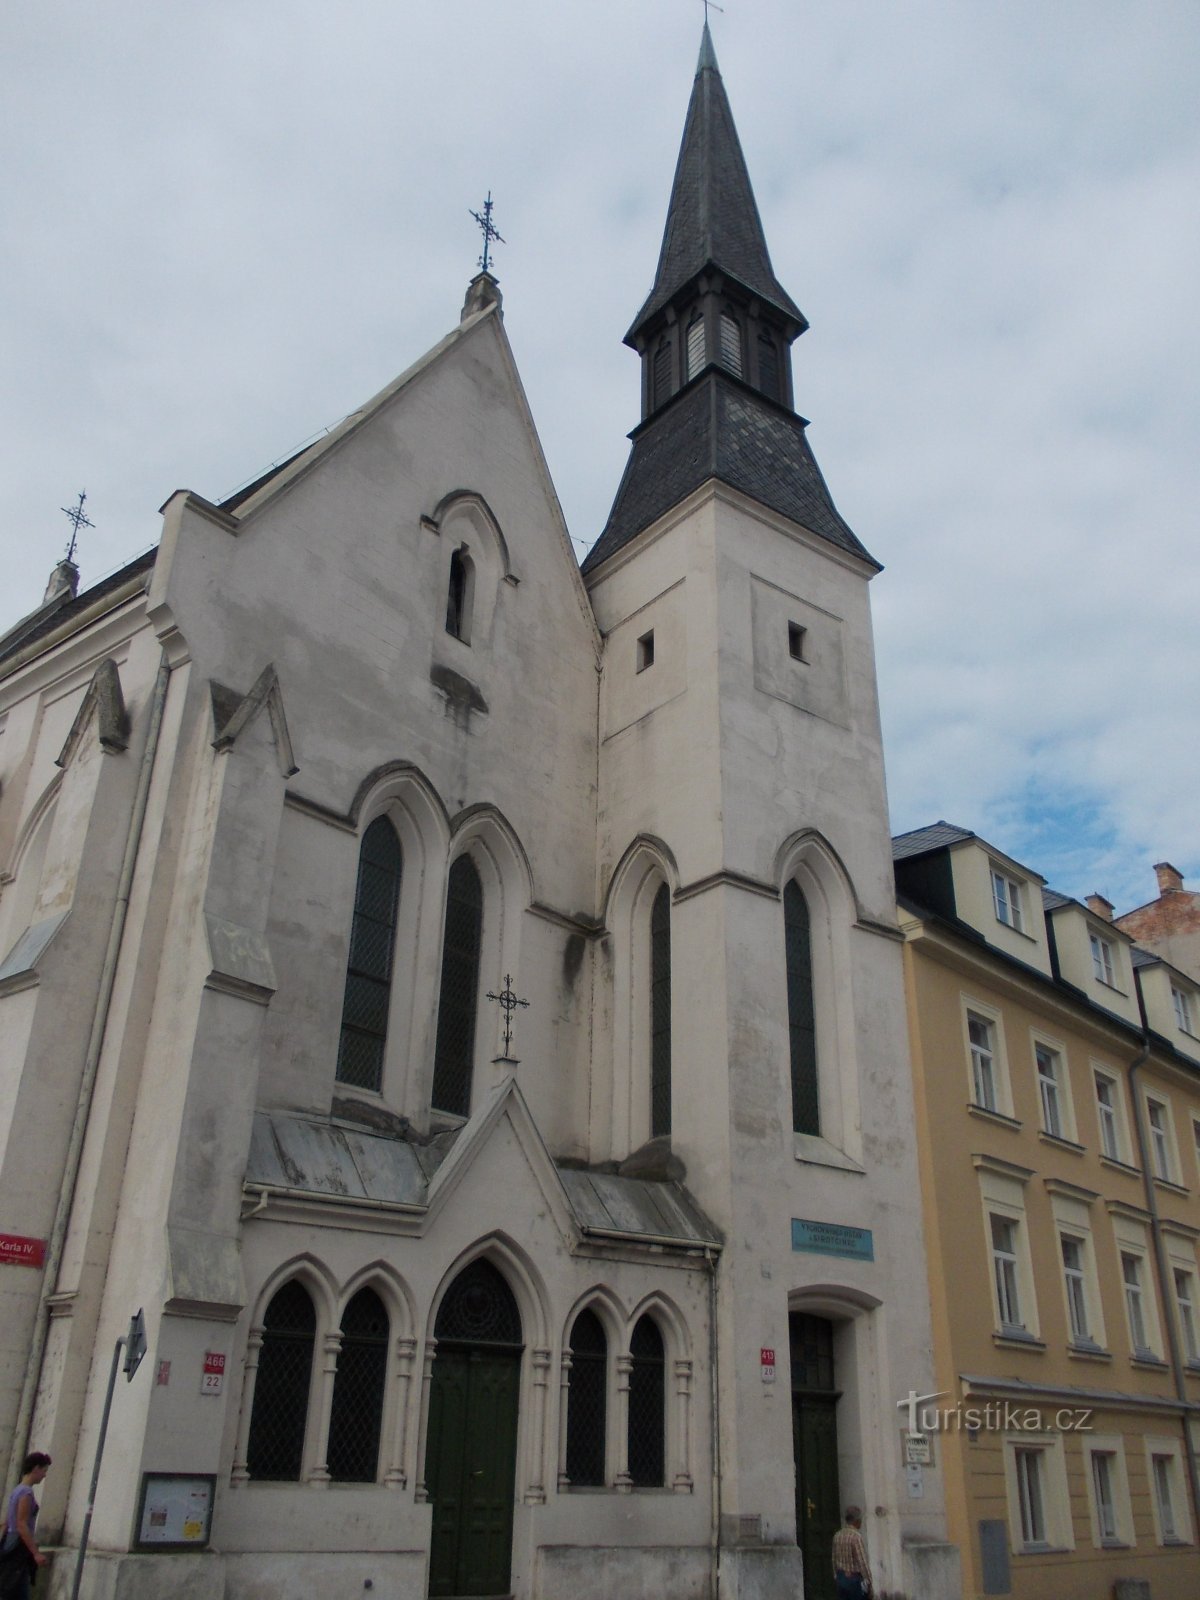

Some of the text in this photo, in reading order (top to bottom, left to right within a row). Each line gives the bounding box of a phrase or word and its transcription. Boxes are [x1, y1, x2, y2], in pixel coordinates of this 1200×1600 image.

[0, 1241, 21, 1252] Karla
[207, 1356, 224, 1367] 466
[207, 1376, 219, 1387] 22
